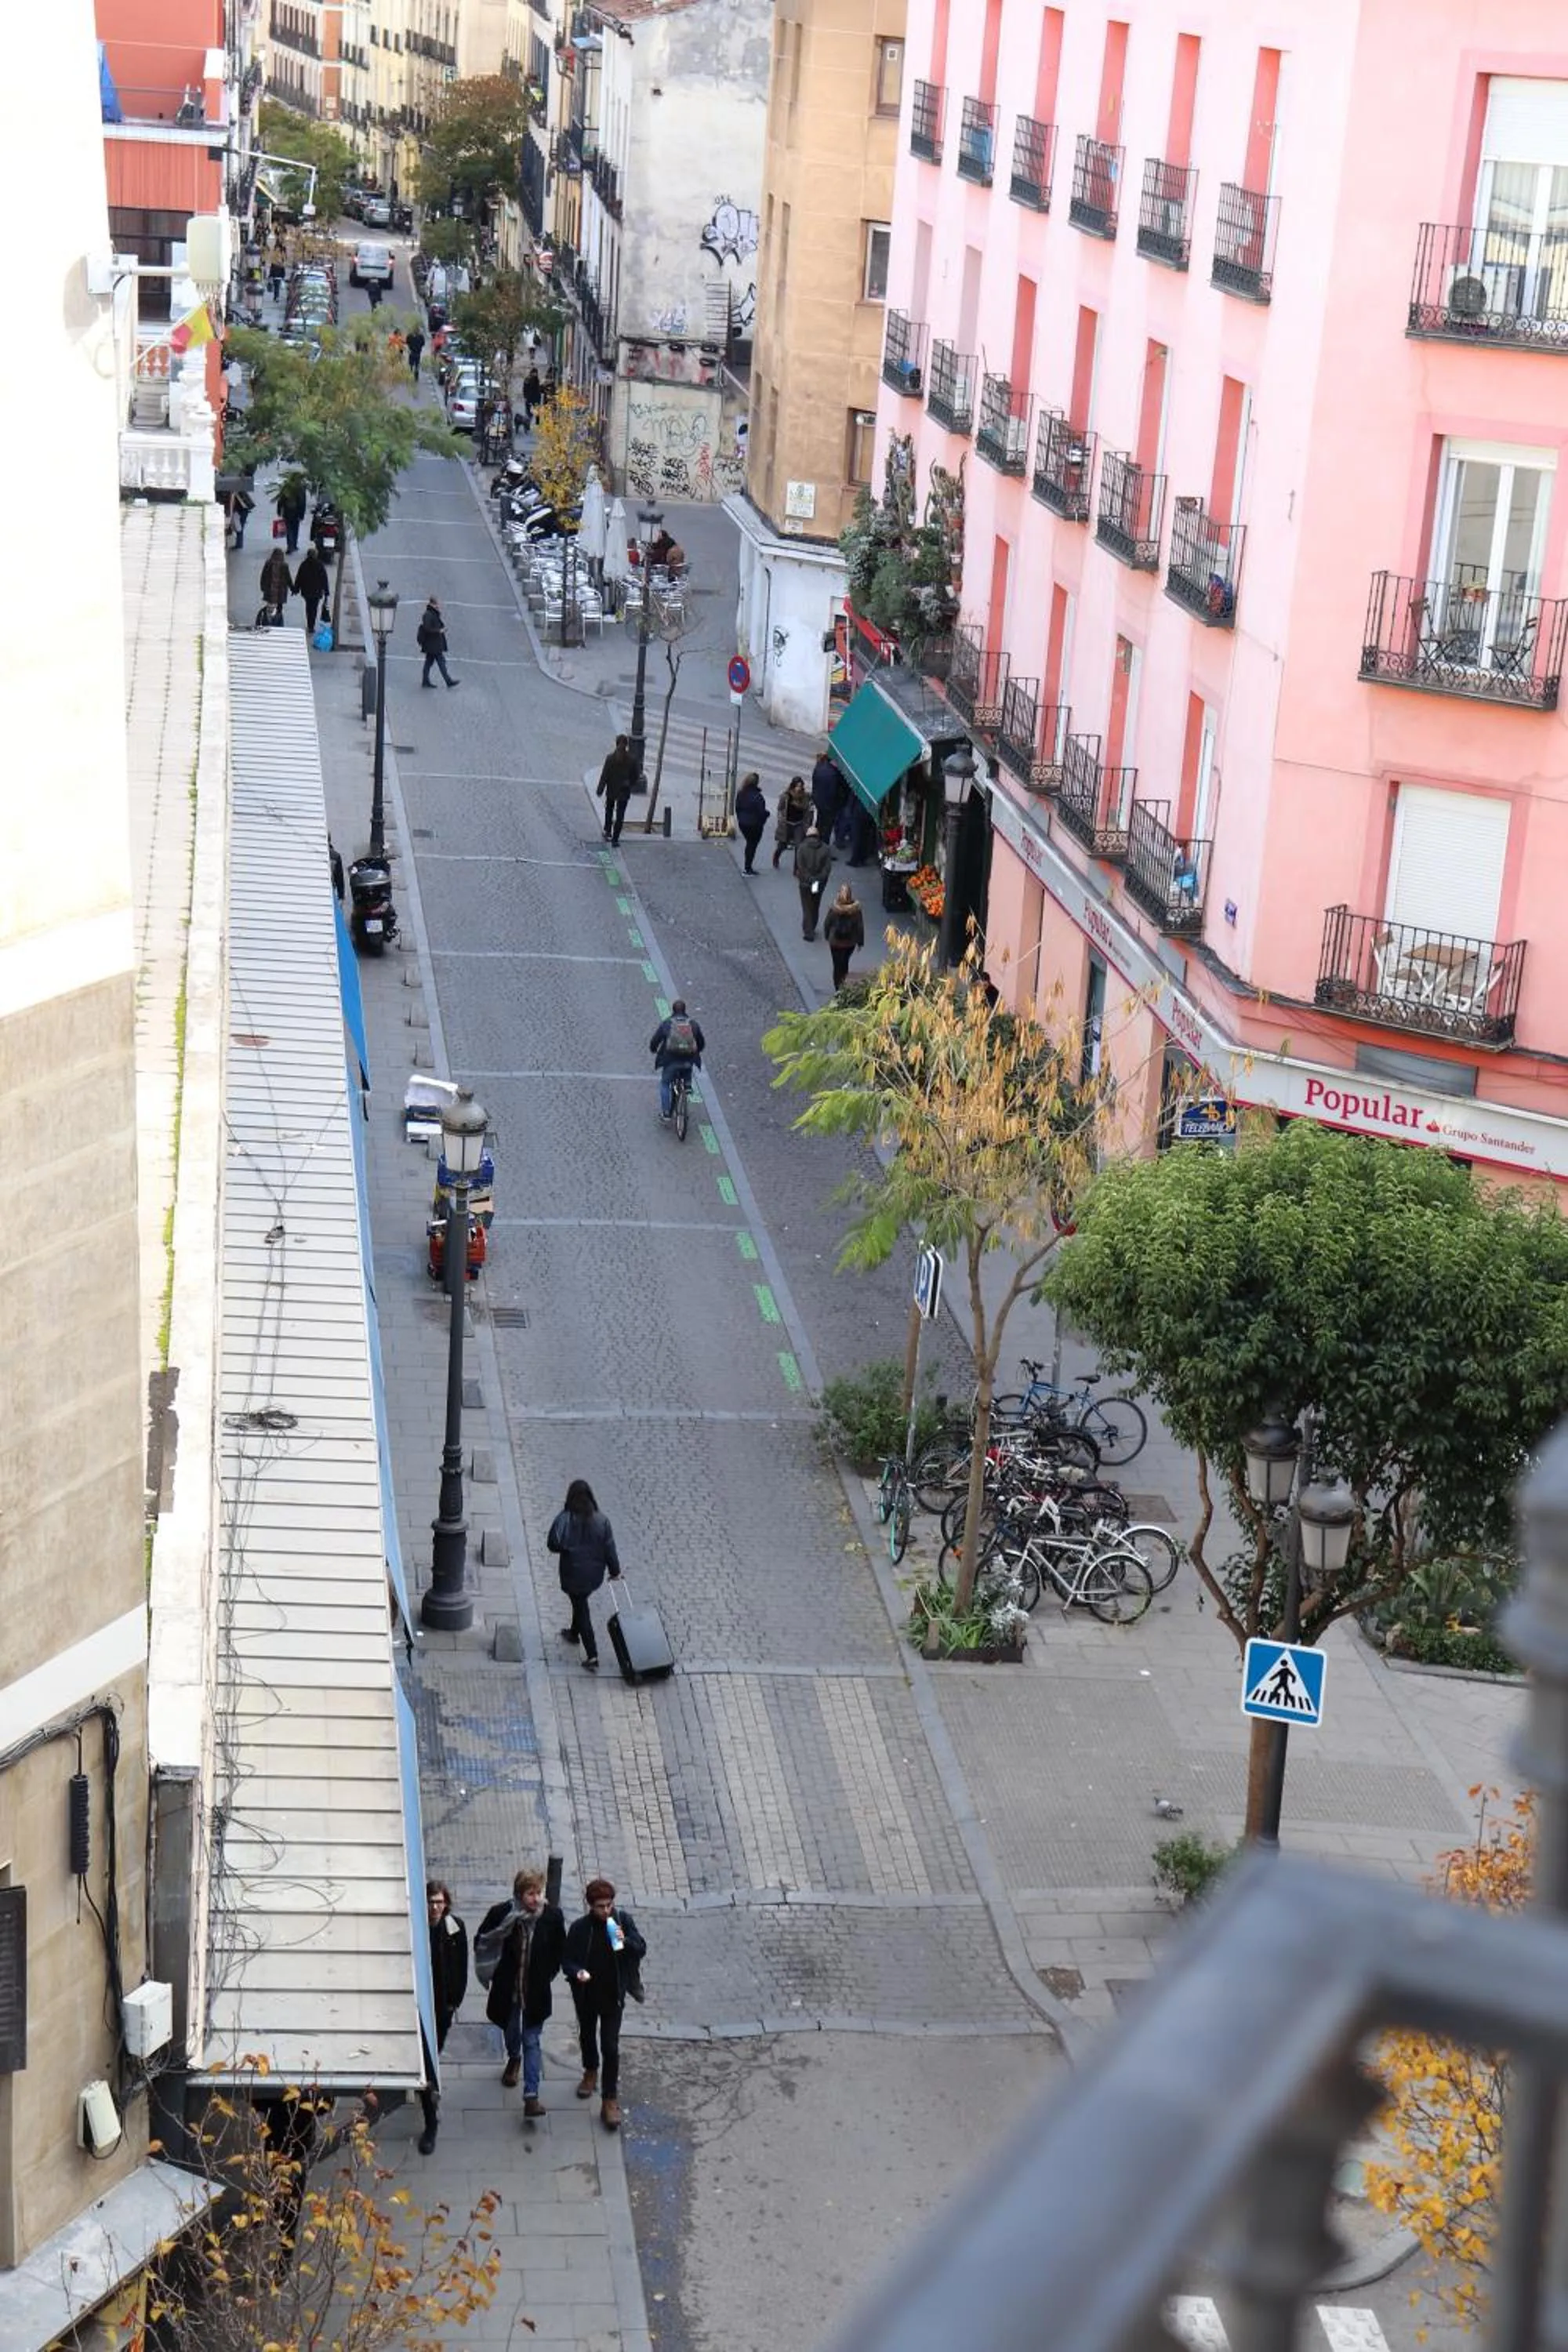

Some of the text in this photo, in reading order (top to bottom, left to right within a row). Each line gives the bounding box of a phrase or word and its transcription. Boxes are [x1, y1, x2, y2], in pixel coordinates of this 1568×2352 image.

[1305, 1079, 1424, 1129] Popular
[1442, 1123, 1536, 1155] Grupo Santander
